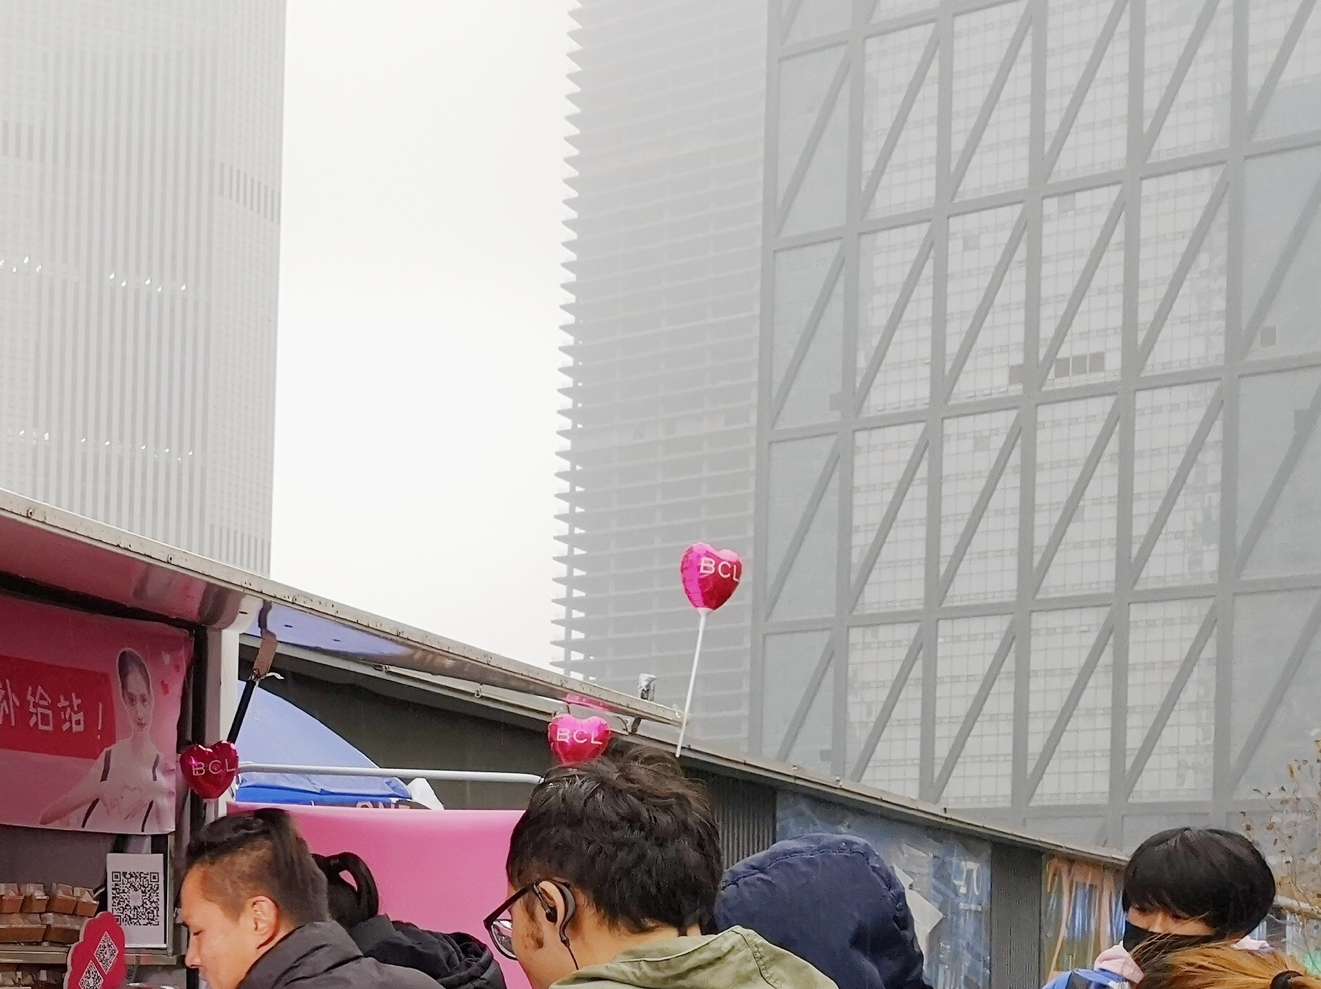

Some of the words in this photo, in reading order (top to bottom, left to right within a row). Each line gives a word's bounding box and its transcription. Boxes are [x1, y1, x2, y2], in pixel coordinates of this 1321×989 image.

[699, 556, 740, 583] BCL
[557, 728, 603, 745] BCL
[191, 758, 236, 776] BCL
